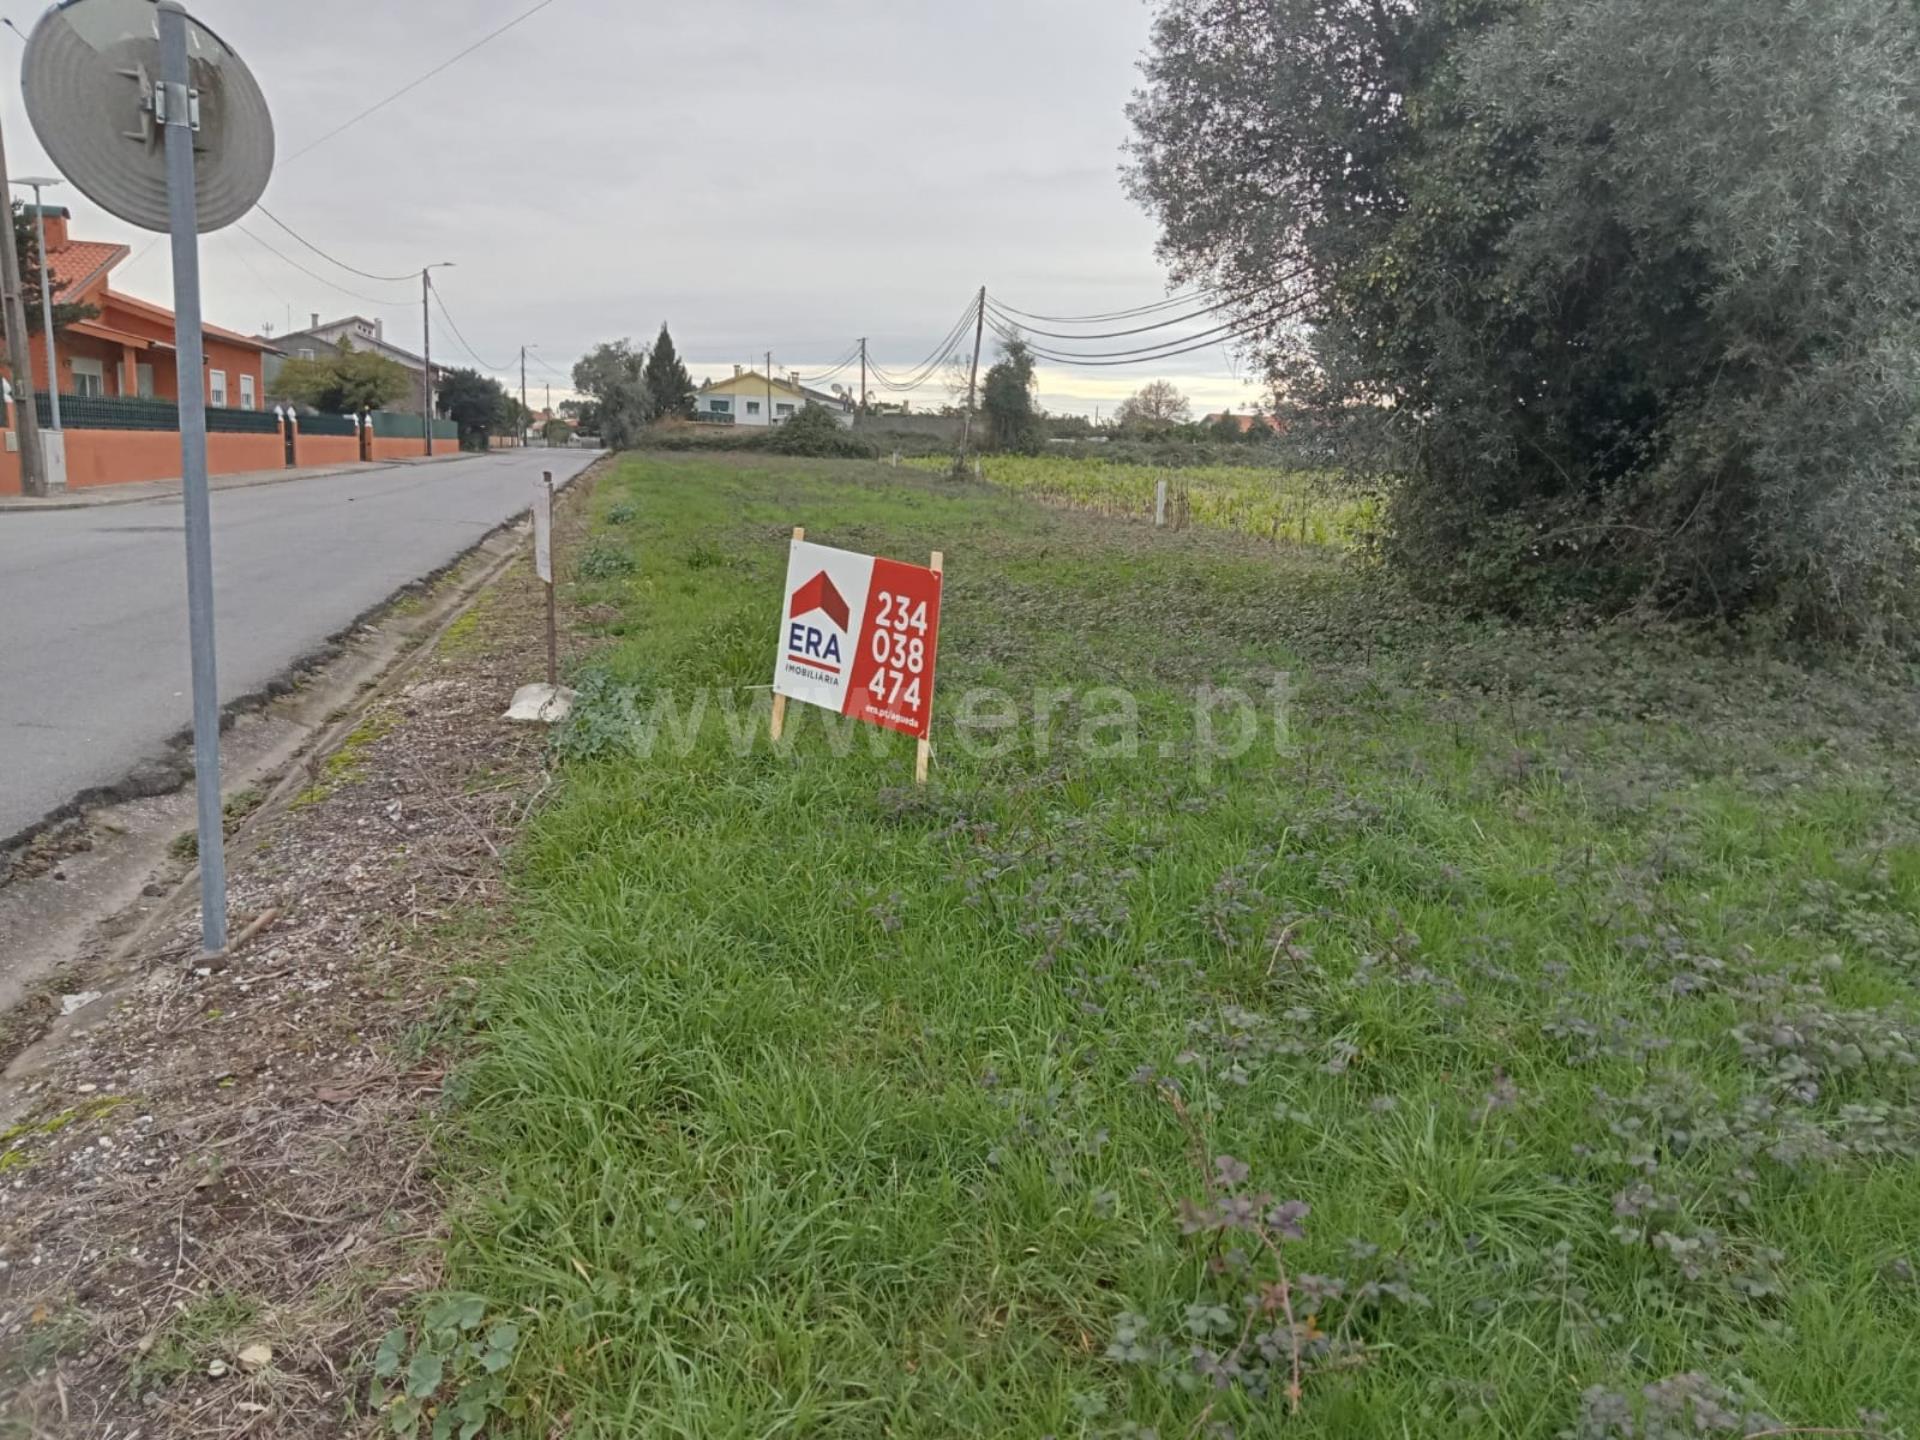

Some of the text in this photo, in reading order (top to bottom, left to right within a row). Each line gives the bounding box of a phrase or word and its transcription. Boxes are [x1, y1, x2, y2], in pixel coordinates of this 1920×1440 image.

[876, 591, 927, 636] 234
[789, 623, 841, 663] ERA
[872, 629, 924, 674] 038
[785, 664, 839, 686] IMOBILIÁRIA
[869, 667, 921, 711] 474
